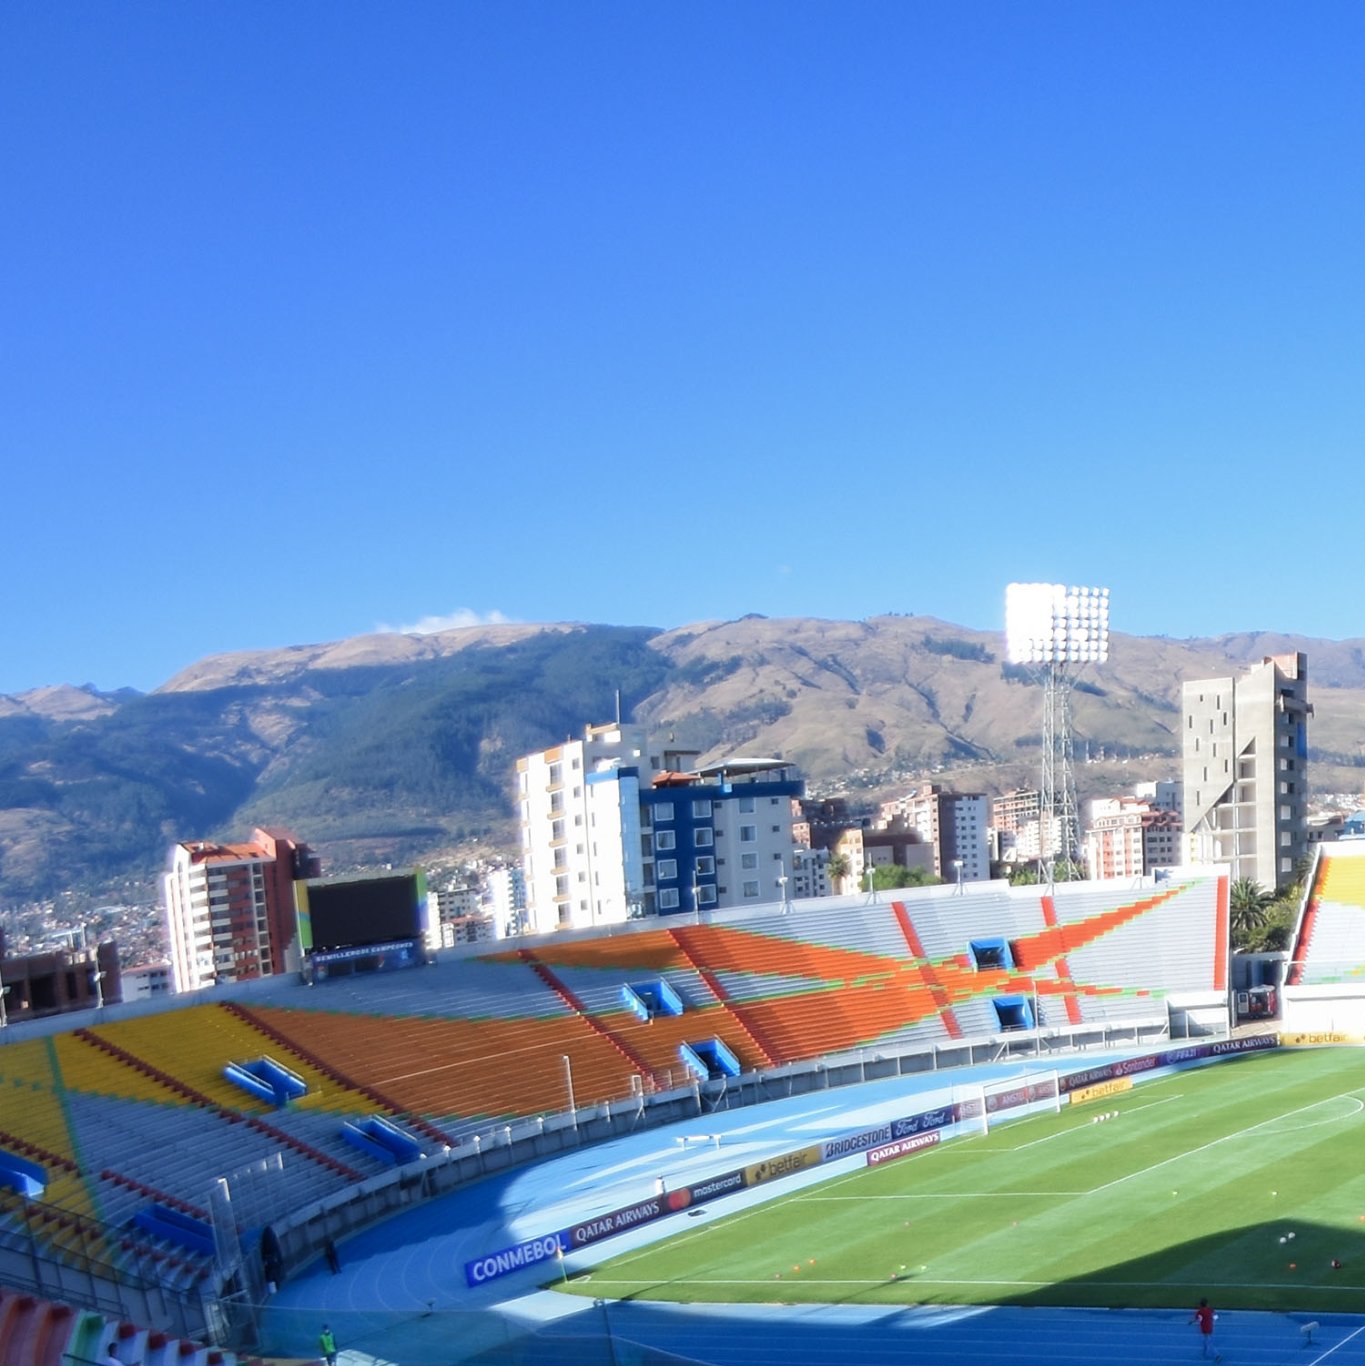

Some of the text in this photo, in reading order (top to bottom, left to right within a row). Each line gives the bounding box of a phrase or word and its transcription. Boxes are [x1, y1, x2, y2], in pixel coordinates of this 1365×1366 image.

[1213, 1035, 1276, 1054] QATAR AIRWAYS
[1308, 1032, 1348, 1044] betfair
[1122, 1057, 1156, 1074] Santander
[895, 1118, 918, 1136] Ford
[922, 1112, 946, 1130] Ford
[825, 1126, 890, 1159] BRIDGESTONE
[870, 1132, 940, 1162] QATAR AIRWAYS
[770, 1152, 808, 1177] betfair
[693, 1173, 742, 1199] mastercard
[576, 1201, 660, 1242] QATAR AIRWAYS
[473, 1234, 567, 1282] CONMEBOL
